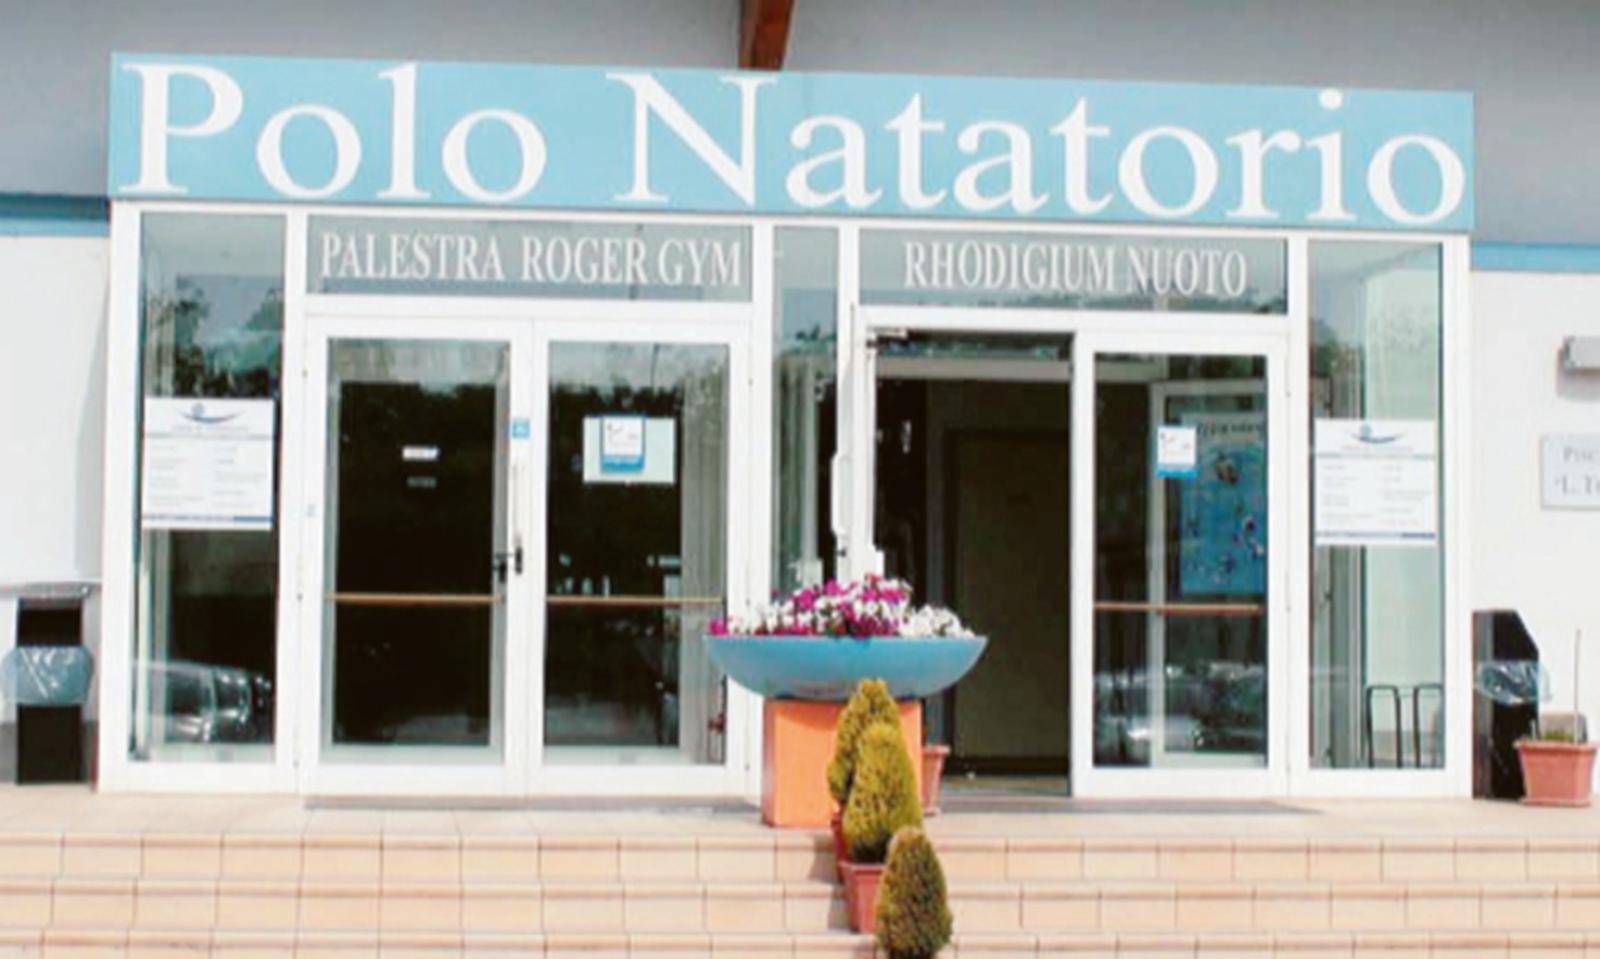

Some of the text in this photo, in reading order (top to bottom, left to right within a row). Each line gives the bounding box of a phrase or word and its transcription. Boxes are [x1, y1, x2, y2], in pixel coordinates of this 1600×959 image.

[119, 62, 1466, 225] Polo Natatorio
[321, 232, 742, 287] PALESTRA ROGER GYM
[904, 240, 1247, 297] RHODIGIUM NUOTO
